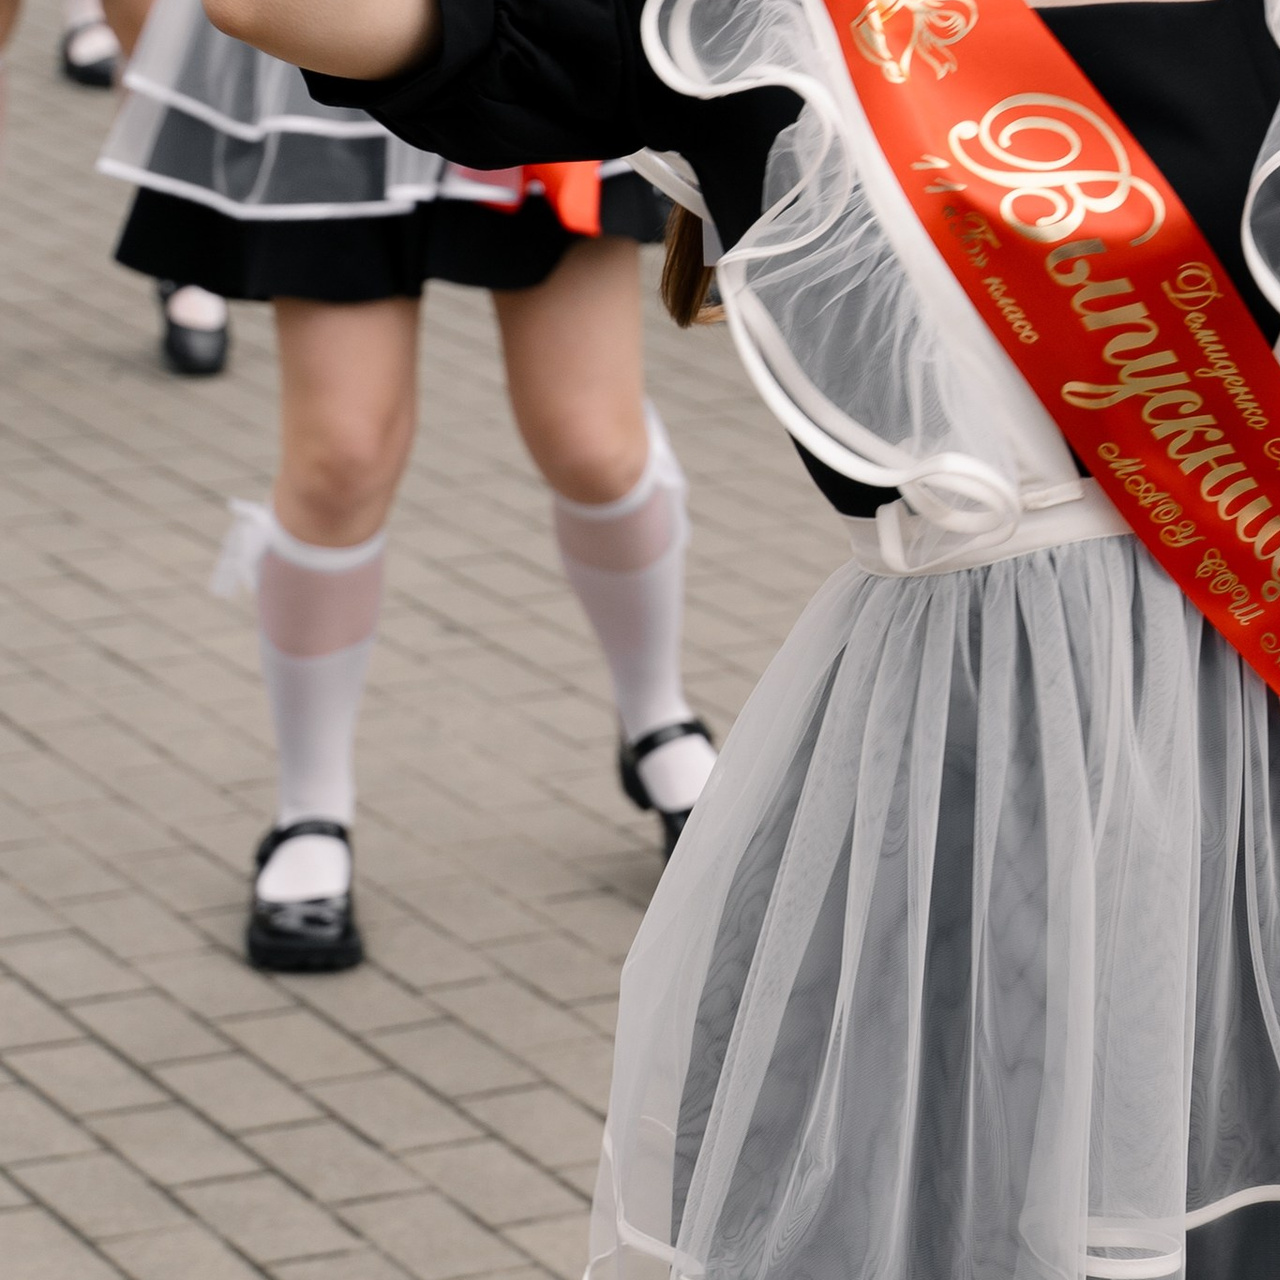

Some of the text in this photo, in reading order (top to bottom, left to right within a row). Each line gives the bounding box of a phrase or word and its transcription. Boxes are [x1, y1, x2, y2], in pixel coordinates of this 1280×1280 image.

[910, 154, 968, 194] 11
[981, 276, 1040, 344] класс
[1161, 261, 1270, 430] Демиденко
[1098, 442, 1206, 548] МАОУ
[1195, 548, 1264, 626] СОШ
